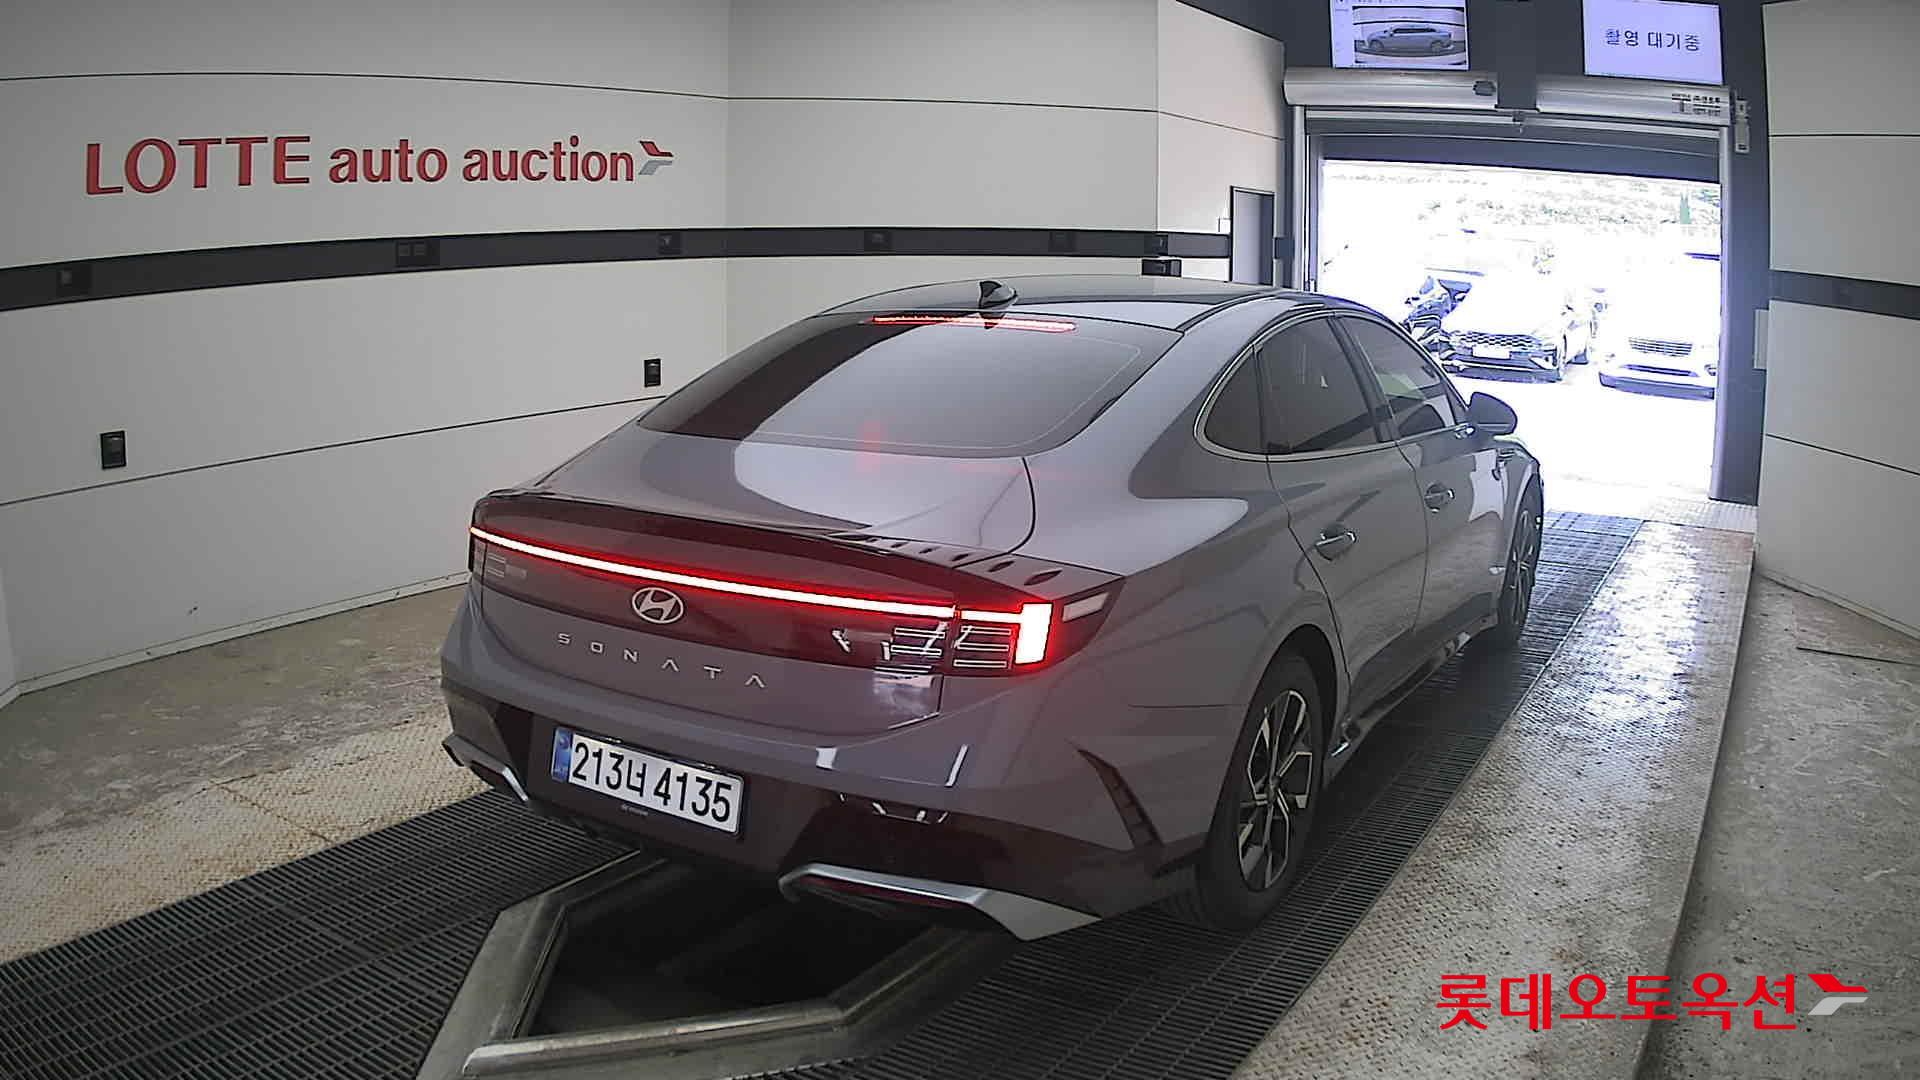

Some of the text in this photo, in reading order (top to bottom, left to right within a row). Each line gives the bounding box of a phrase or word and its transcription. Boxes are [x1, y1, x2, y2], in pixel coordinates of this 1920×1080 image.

[1647, 31, 1700, 52] 대기중
[86, 134, 635, 196] LOTTE auto auction
[557, 631, 767, 690] SONATA
[572, 742, 732, 823] 213너 4135
